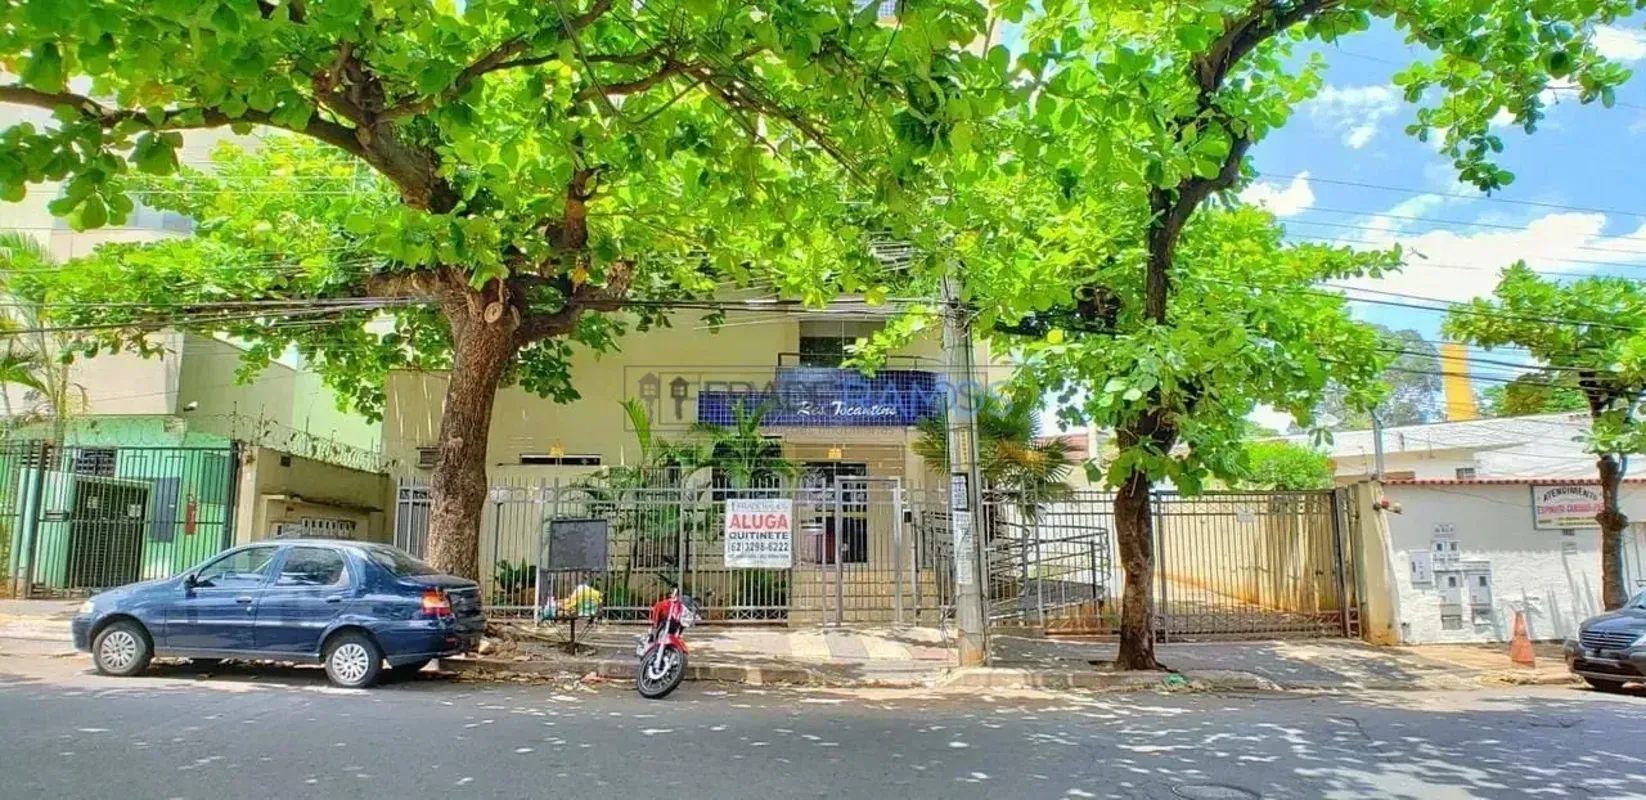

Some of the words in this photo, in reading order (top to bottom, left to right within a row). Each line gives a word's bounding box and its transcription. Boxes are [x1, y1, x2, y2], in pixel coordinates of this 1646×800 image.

[831, 401, 898, 416] Tocantins
[1542, 487, 1599, 502] ATENDIMENTO
[730, 514, 788, 529] ALUGA
[729, 532, 789, 540] QUITINETE
